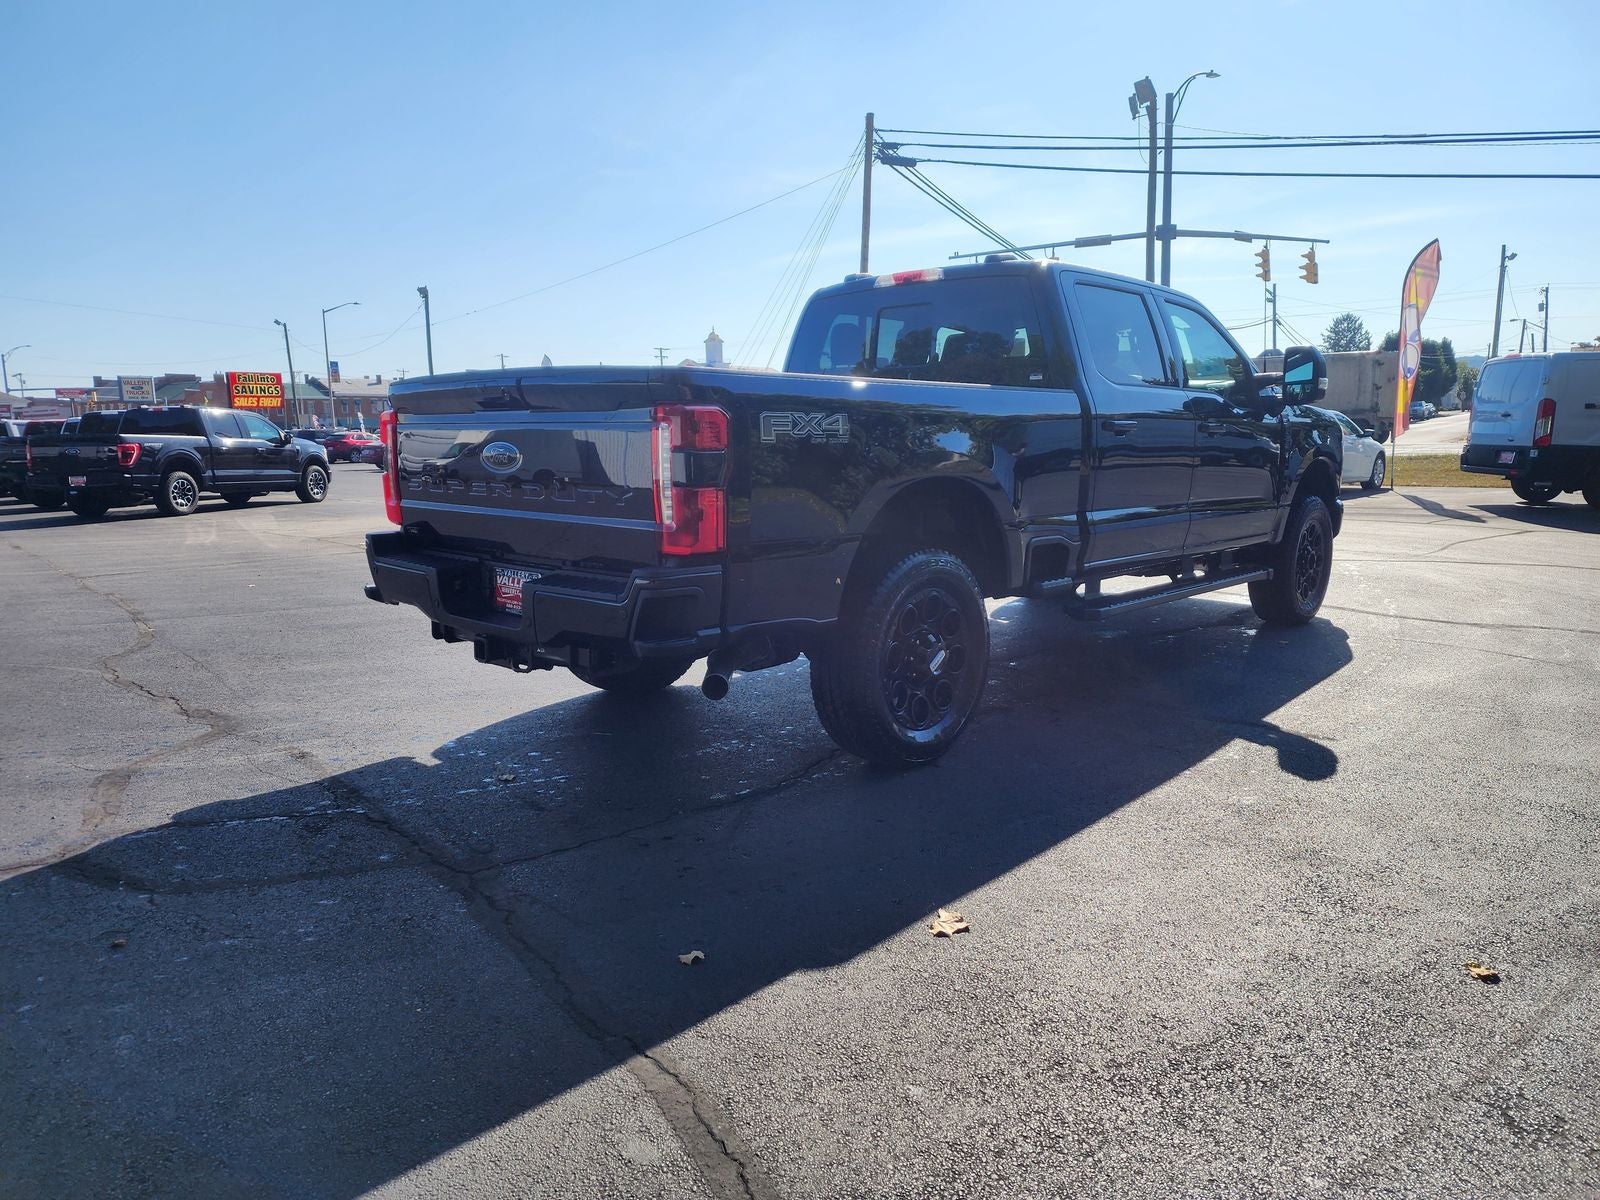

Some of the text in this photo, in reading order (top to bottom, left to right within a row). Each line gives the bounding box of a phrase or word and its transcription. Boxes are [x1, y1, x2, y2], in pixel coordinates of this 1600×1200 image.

[237, 373, 276, 383] Fall Into
[233, 384, 281, 396] SAVINGS
[233, 397, 282, 407] SALES EVENT
[760, 411, 850, 443] FX4
[408, 477, 634, 506] SUPER DUTY
[504, 569, 529, 579] VALLERY
